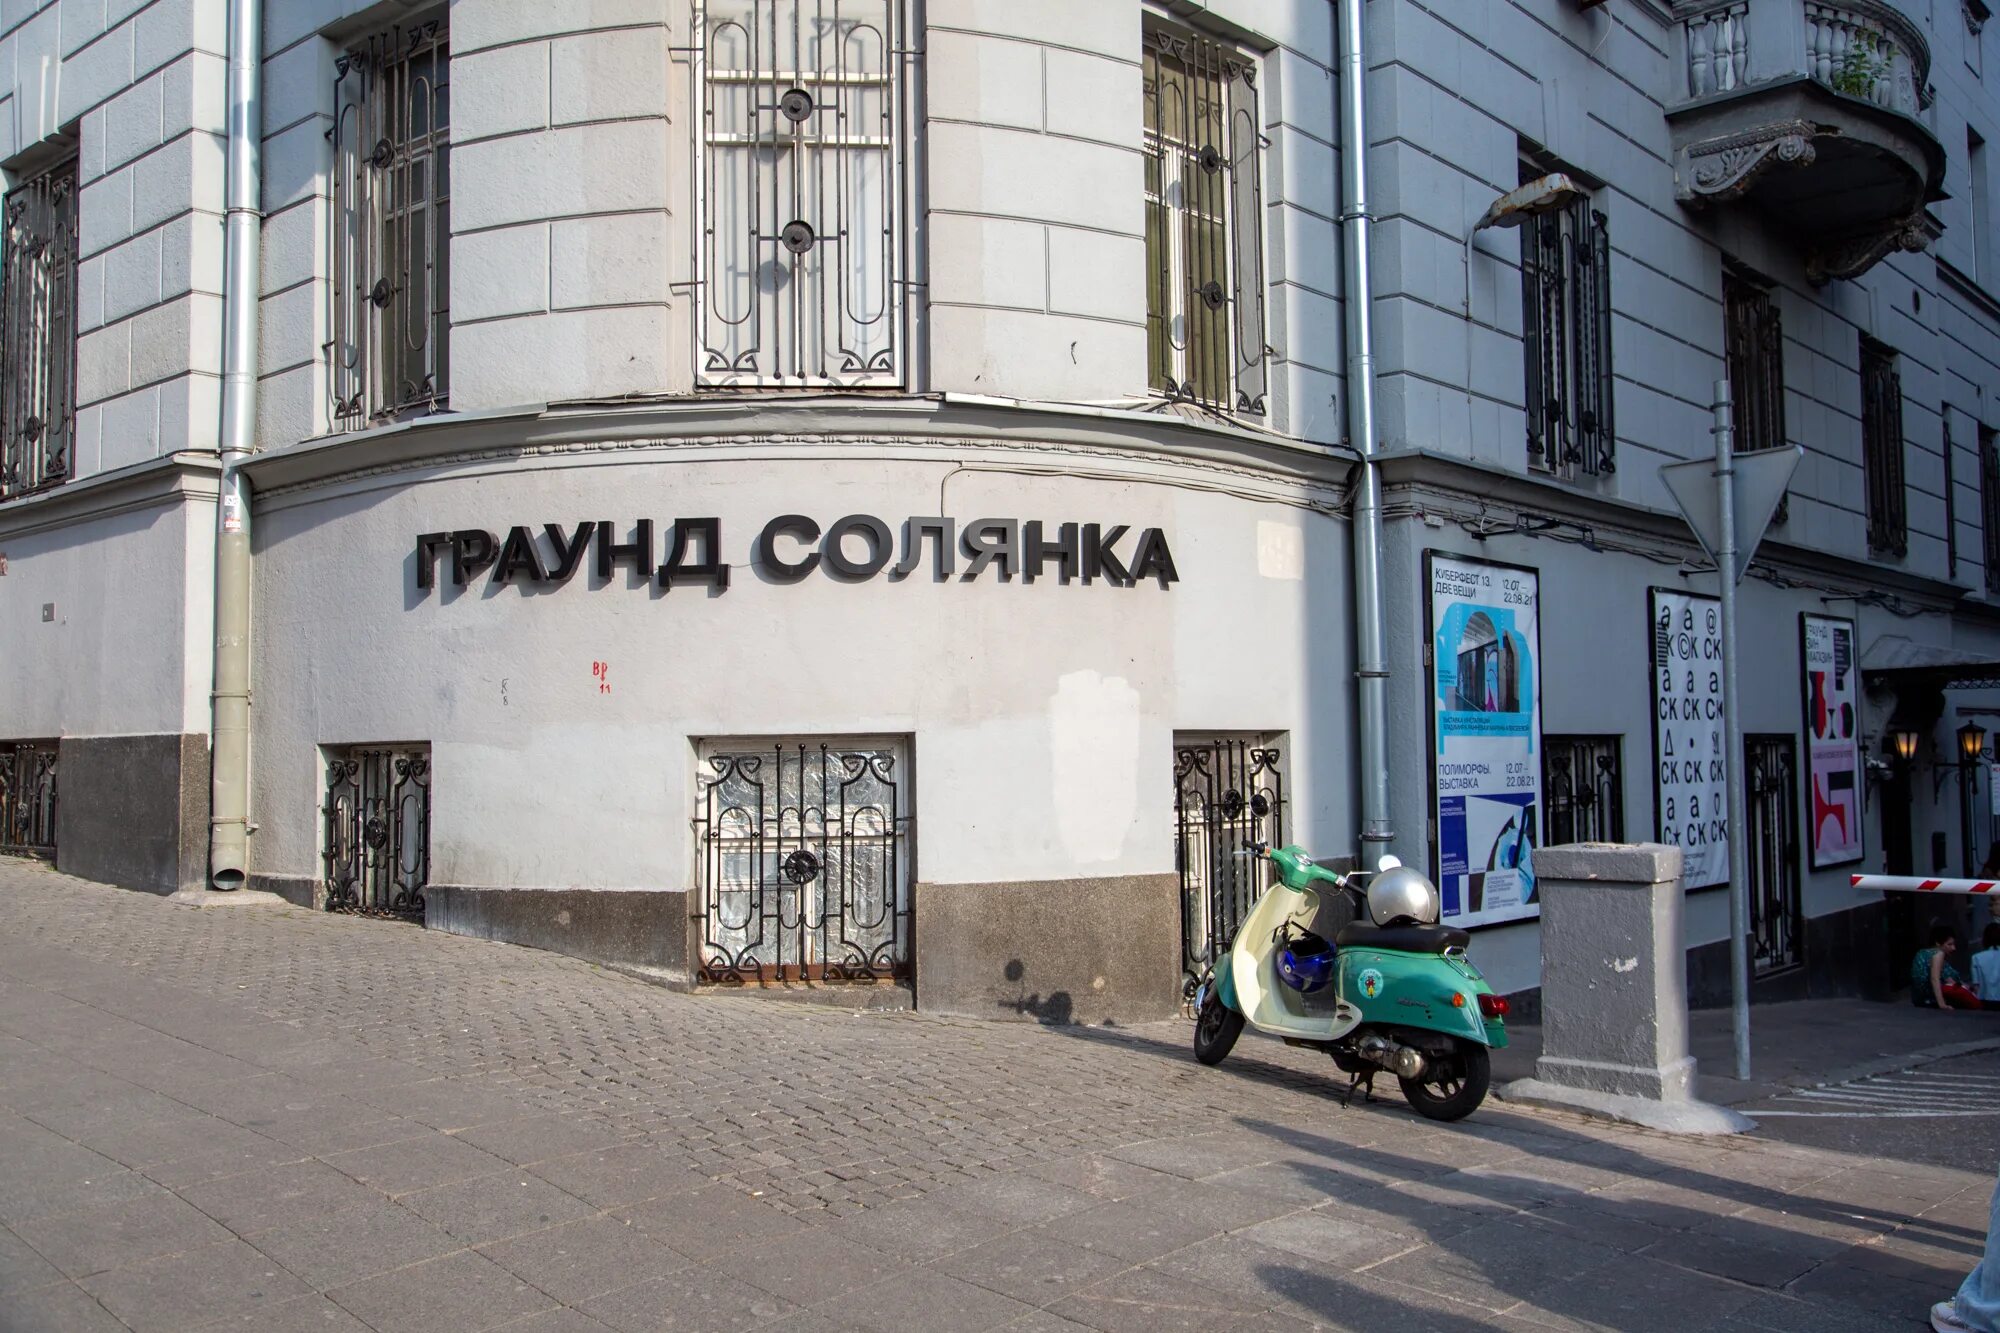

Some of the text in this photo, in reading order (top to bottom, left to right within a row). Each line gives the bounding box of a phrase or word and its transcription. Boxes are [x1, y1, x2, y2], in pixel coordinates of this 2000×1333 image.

[416, 513, 1180, 590] ГРАУНД СОЛЯНКА
[1435, 582, 1476, 599] ДВЕ ВЕЩИ
[1503, 592, 1532, 606] 22.08.21
[1506, 762, 1523, 774] 12.07
[1439, 777, 1479, 790] ВЫСТАВКА
[1506, 775, 1535, 788] 22.08.21
